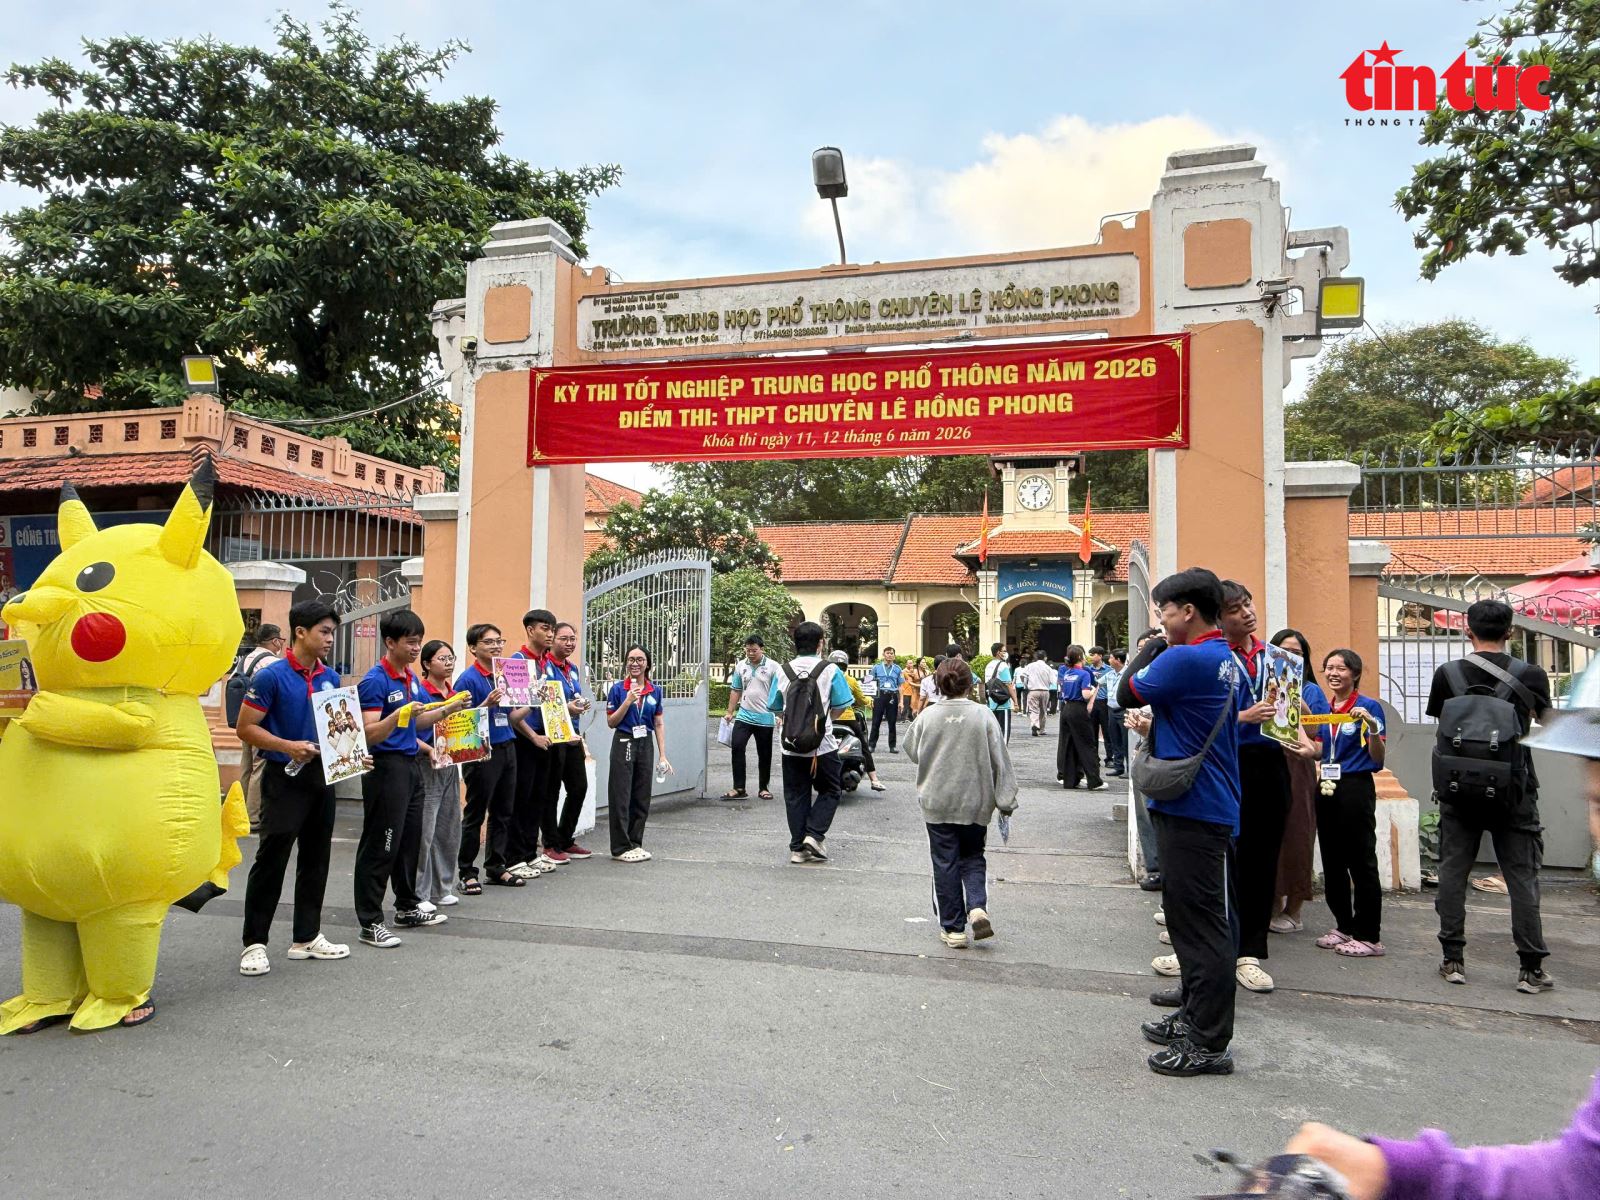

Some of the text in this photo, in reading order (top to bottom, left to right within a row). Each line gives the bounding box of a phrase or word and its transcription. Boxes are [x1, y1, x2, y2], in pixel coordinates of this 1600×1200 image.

[592, 281, 1120, 339] TRƯỜNG TRUNG HỌC PHỔ THÔNG CHUYÊN LÊ HỒNG PHONG
[554, 357, 1157, 403] KỲ THI TỐT NGHIỆP TRUNG HỌC PHỔ THÔNG NĂM 2026
[618, 392, 1073, 429] ĐIỂM THI: THPT CHUYÊN LÊ HỒNG PHONG
[702, 426, 972, 449] Khóa thi ngày 11, 12 tháng 6 năm 2026
[1042, 580, 1067, 592] PHONG
[385, 828, 393, 852] NIKE
